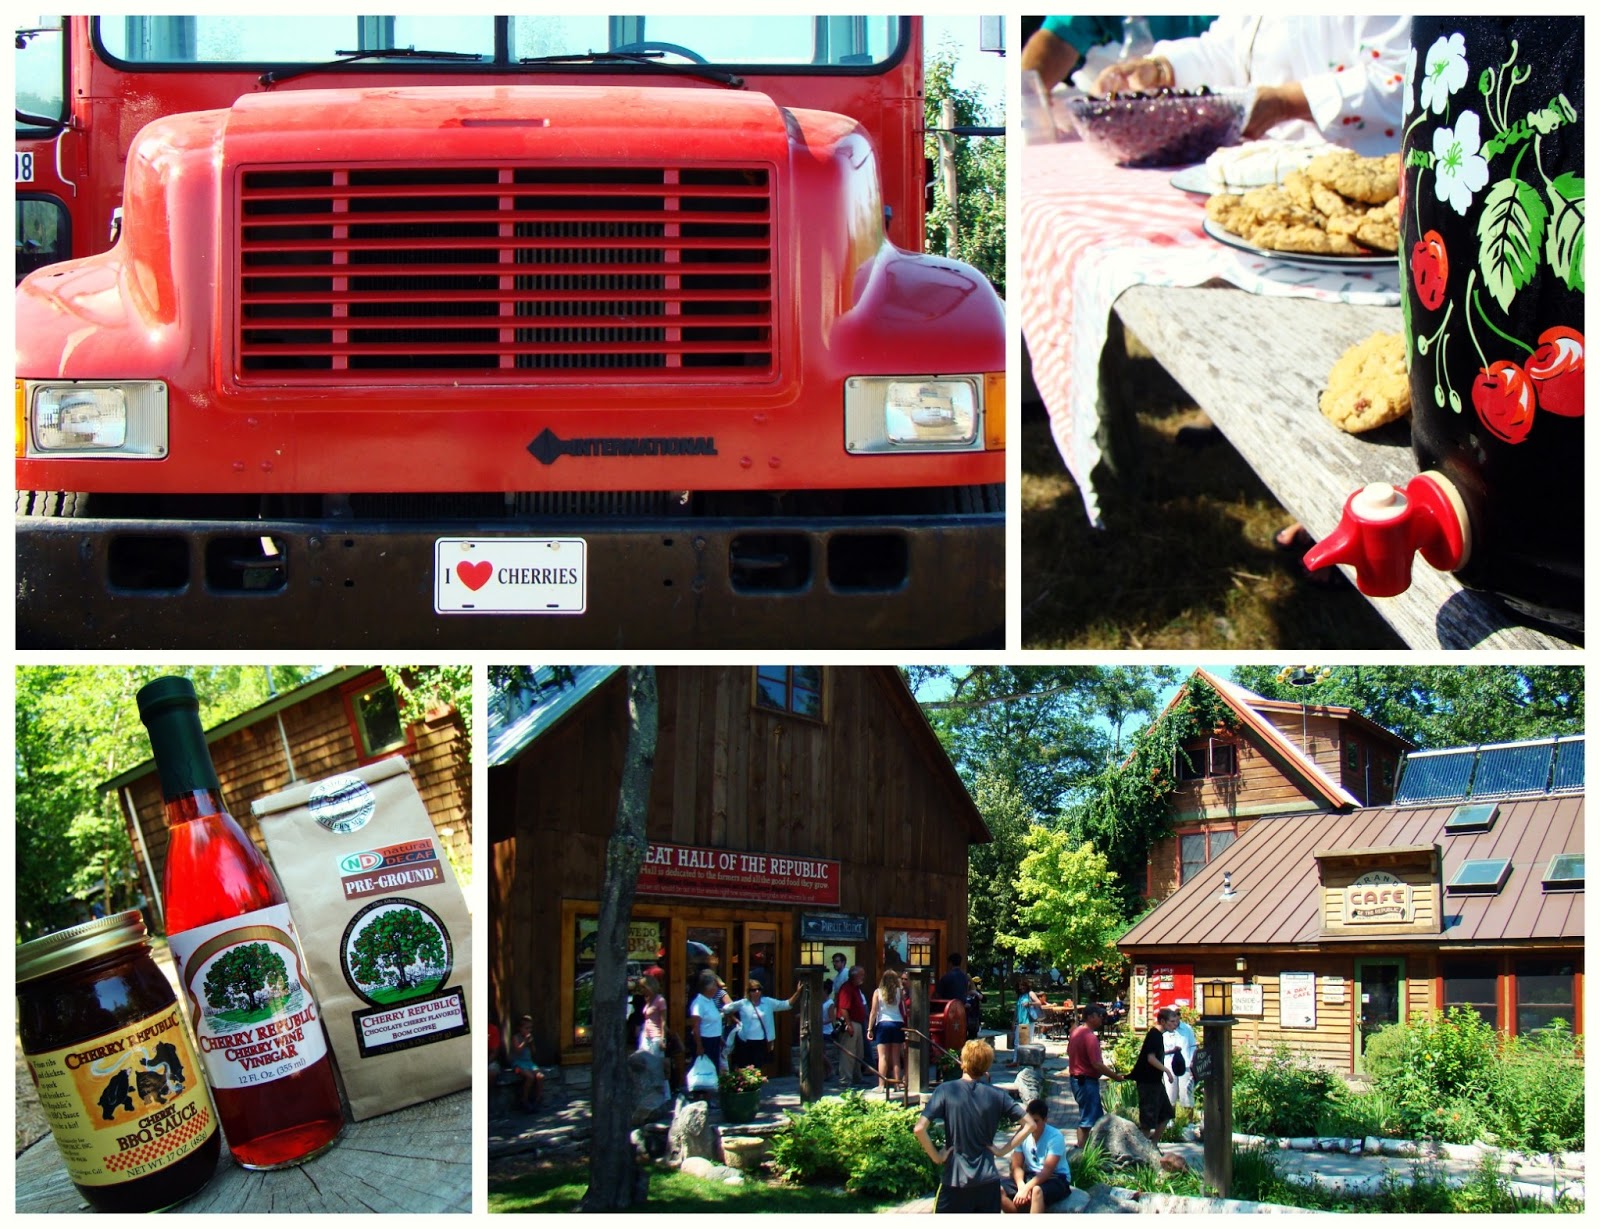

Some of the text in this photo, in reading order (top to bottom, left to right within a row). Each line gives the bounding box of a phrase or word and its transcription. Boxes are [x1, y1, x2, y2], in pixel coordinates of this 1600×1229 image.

[570, 437, 718, 456] INTERNATIONAL
[445, 567, 577, 585] I CHERRIES
[383, 840, 431, 856] natural
[385, 850, 433, 865] DECAF
[645, 846, 829, 879] EAT HALL OF THE REPUBLIC
[345, 866, 439, 894] PRE-GROUND!
[1350, 889, 1405, 905] CAFE
[643, 928, 656, 937] DO
[1135, 967, 1147, 1026] EVNTS
[362, 997, 459, 1028] CHERRY REPUBLIC
[364, 1008, 460, 1037] CHOCOLATE CHERRY FLAVORED
[64, 1038, 126, 1070] CHERRY
[127, 1010, 180, 1047] REPUBLIC
[199, 1003, 316, 1053] CHERRY REPUBLIC
[392, 1023, 437, 1039] BOOM COFFEE
[224, 1027, 305, 1062] CHERRY WINE
[238, 1044, 299, 1071] VINEGAR
[238, 1075, 248, 1084] 12
[260, 1070, 276, 1080] Oz.
[276, 1062, 293, 1076] (355
[63, 1111, 79, 1119] Sauce
[116, 1101, 198, 1151] BBQ SAUCE
[138, 1104, 178, 1129] CHERRY
[127, 1164, 146, 1178] NET
[148, 1157, 165, 1171] WT.
[165, 1151, 176, 1163] 17
[176, 1144, 191, 1158] OZ.
